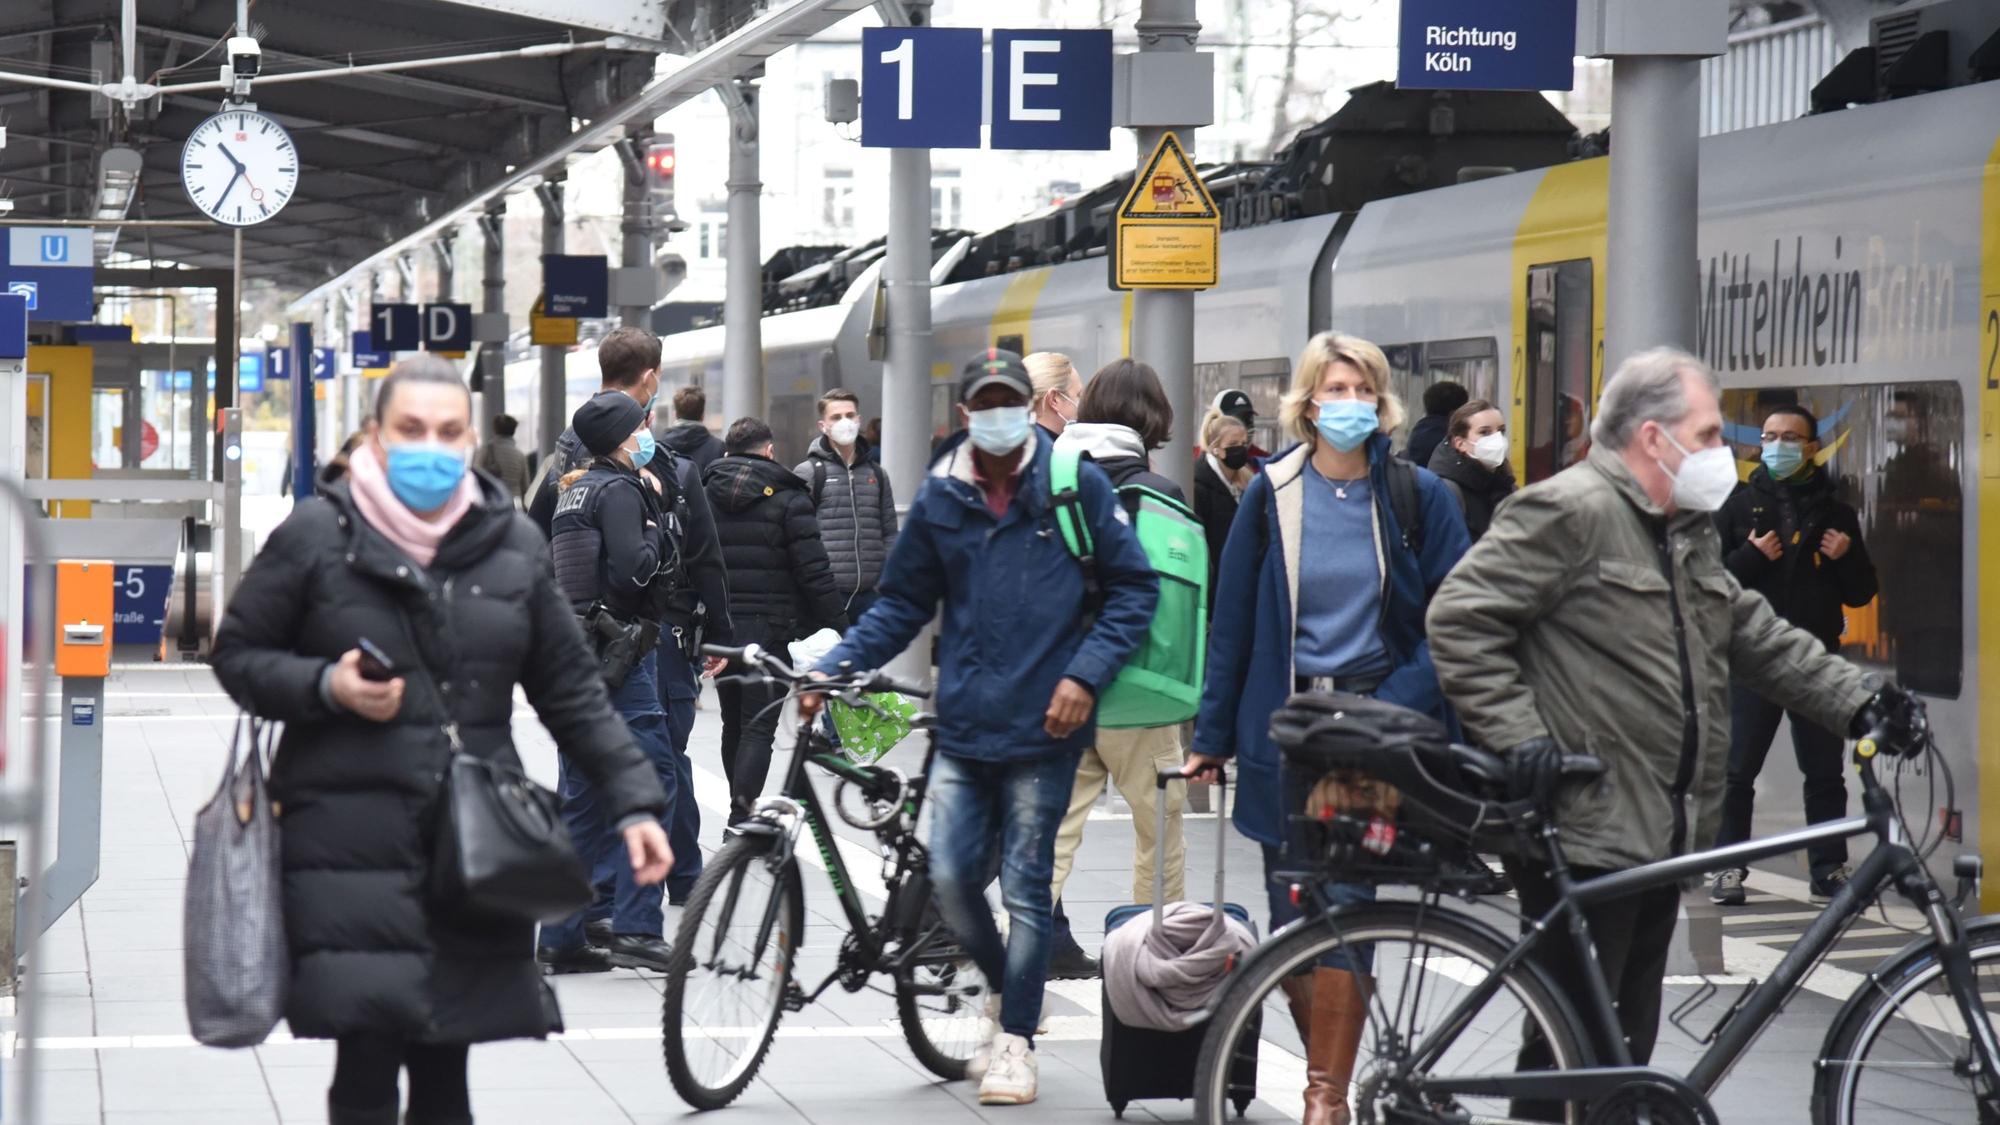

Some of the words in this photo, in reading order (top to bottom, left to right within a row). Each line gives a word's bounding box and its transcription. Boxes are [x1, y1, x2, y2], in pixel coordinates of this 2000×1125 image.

[1426, 26, 1517, 51] Richtung
[1425, 51, 1472, 72] Köln
[880, 38, 914, 120] 1
[1009, 40, 1061, 121] E
[45, 236, 64, 261] U
[377, 307, 393, 341] 1
[430, 307, 456, 342] D
[270, 349, 283, 374] 1
[556, 486, 589, 515] LIZEI
[113, 611, 144, 624] traße
